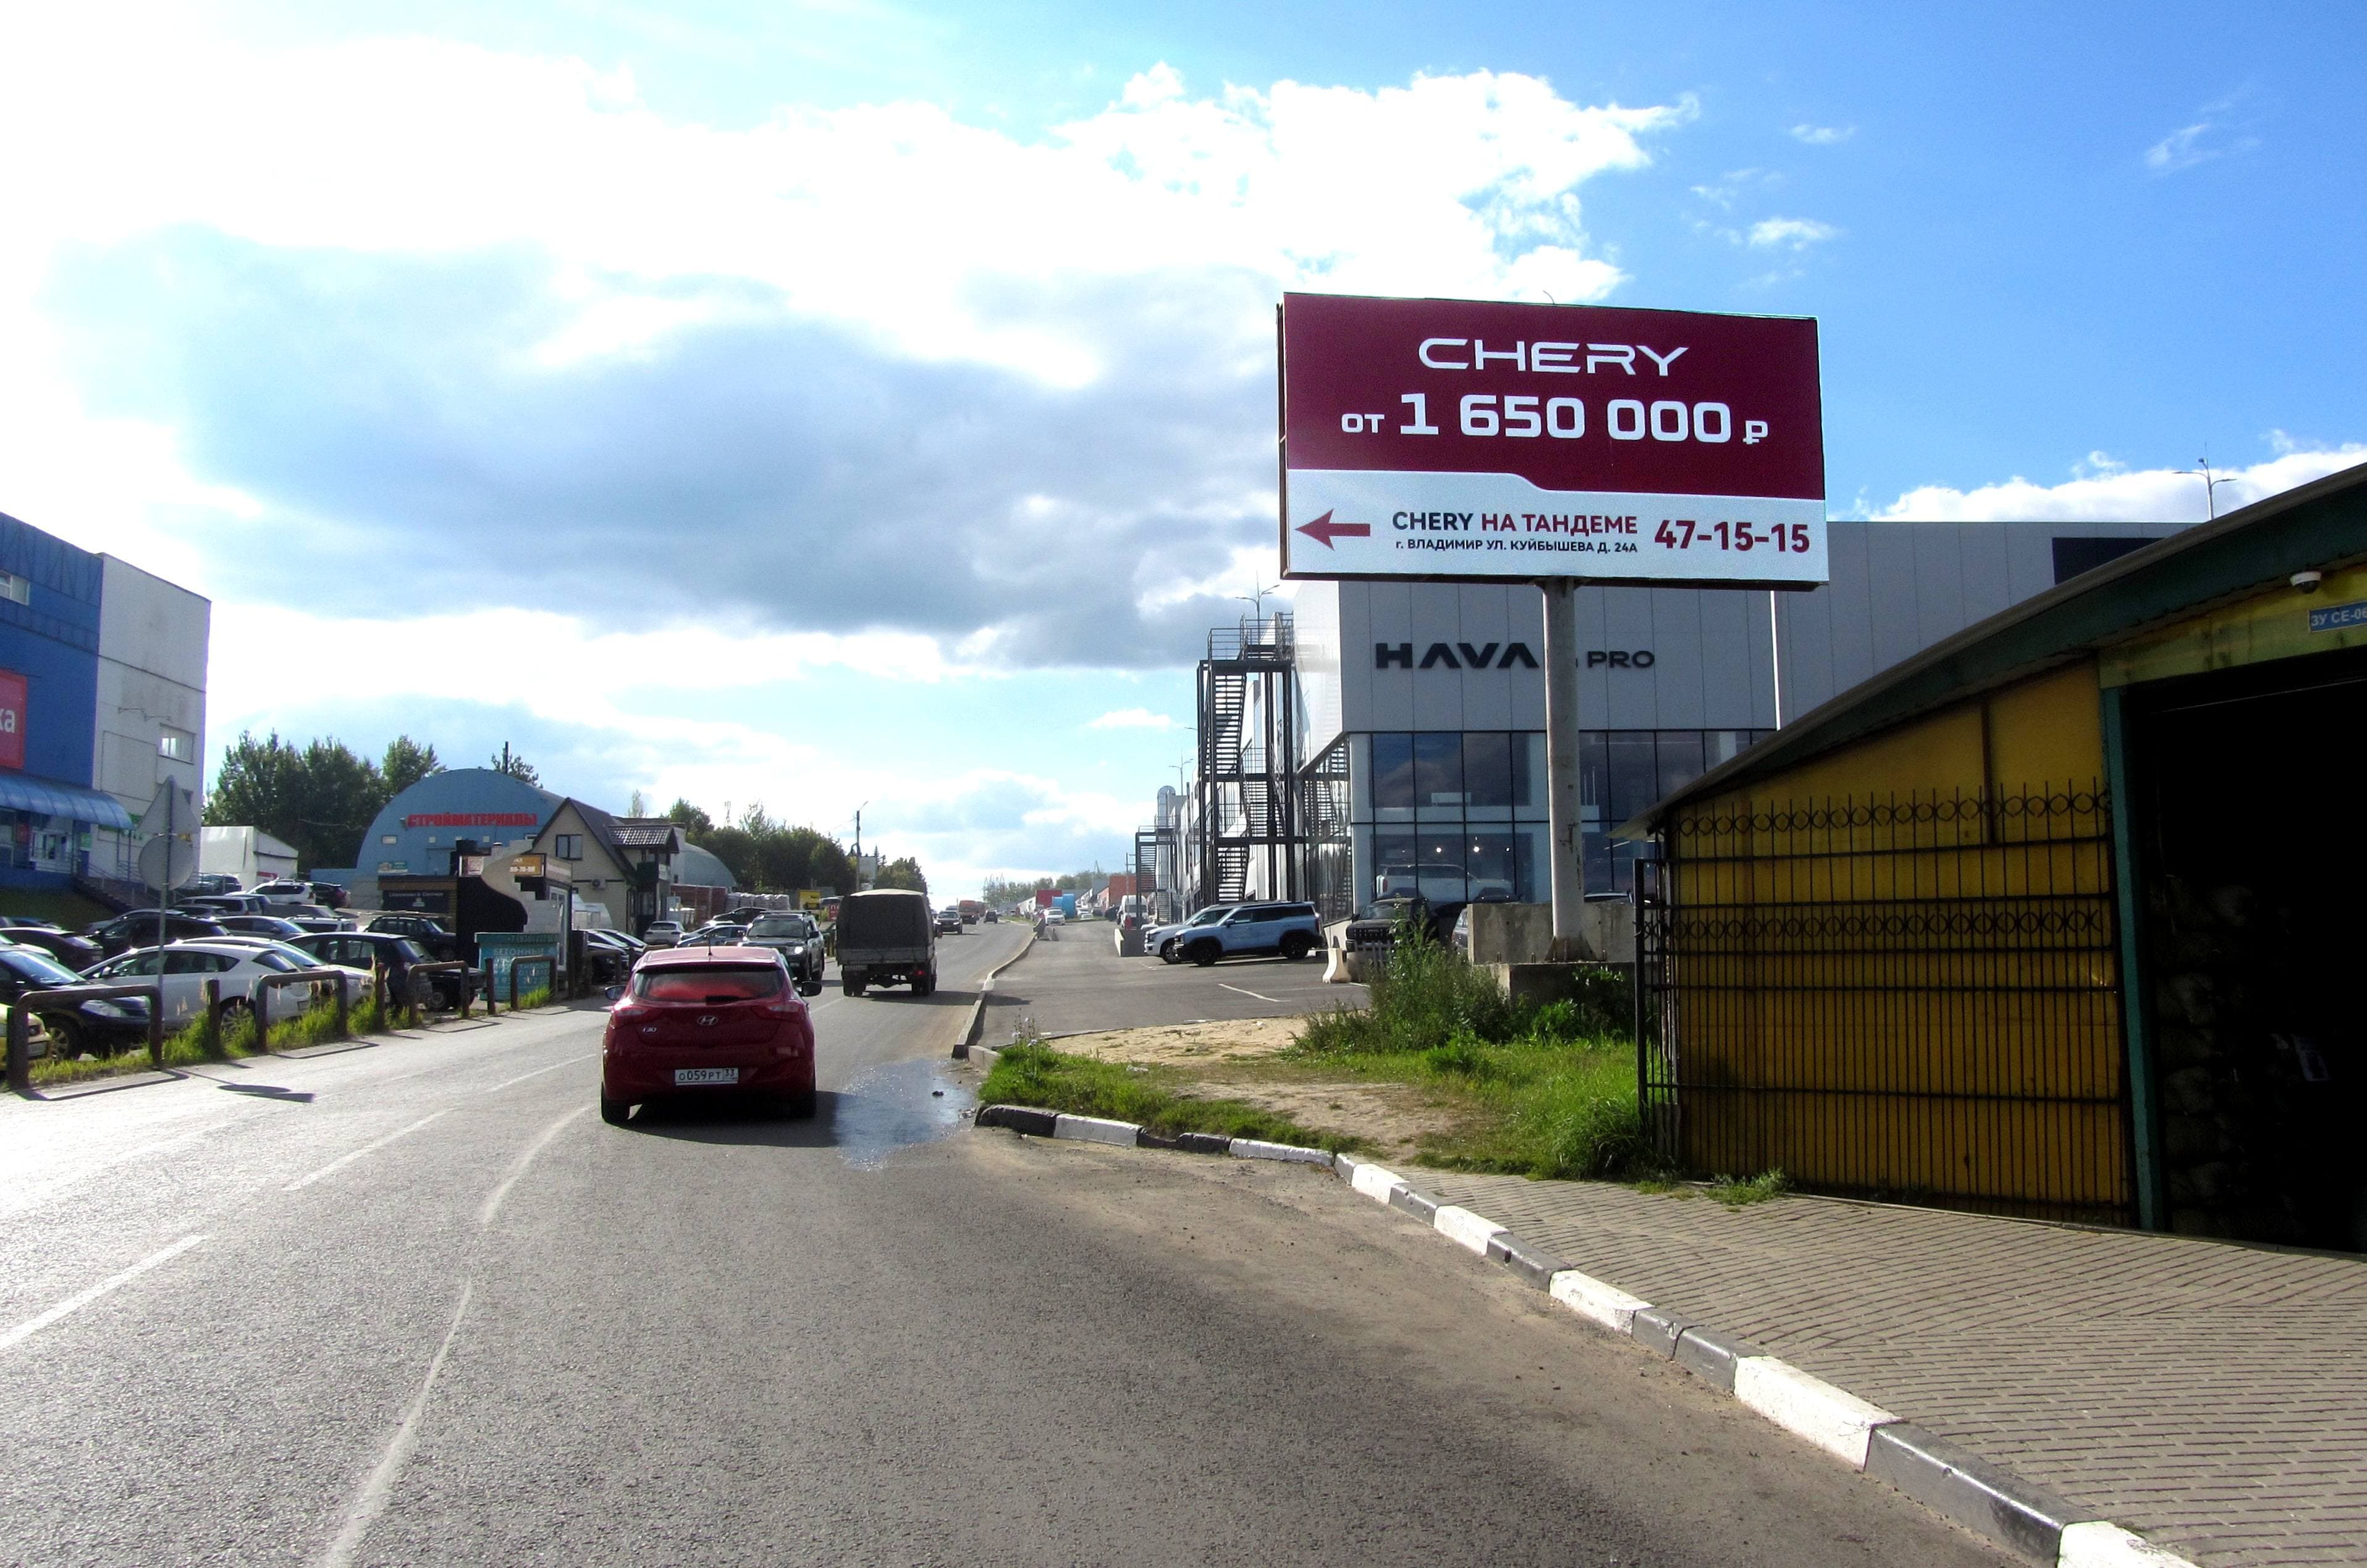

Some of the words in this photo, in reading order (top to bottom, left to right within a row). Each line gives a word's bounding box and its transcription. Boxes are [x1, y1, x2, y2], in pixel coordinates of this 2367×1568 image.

[1418, 337, 1689, 376] CHERY
[1400, 393, 1439, 435] 1
[1459, 394, 1585, 439] 650
[1607, 398, 1731, 443] 000
[1392, 511, 1474, 531] CHERY
[1482, 513, 1517, 532] НА
[1521, 513, 1638, 537] ТАНДЕМЕ
[1654, 519, 1810, 553] 47-15-15
[1407, 539, 1483, 552] ВЛАДИМИР
[1486, 539, 1507, 550] УЛ.
[1510, 538, 1595, 552] КУЙБЫШЕВА
[1597, 542, 1611, 554] Д.
[1375, 642, 1578, 669] HAVA
[1587, 650, 1655, 668] PRO
[407, 813, 538, 827] СТРОЙМАТЕРИАЛЫ
[724, 1068, 735, 1077] 33
